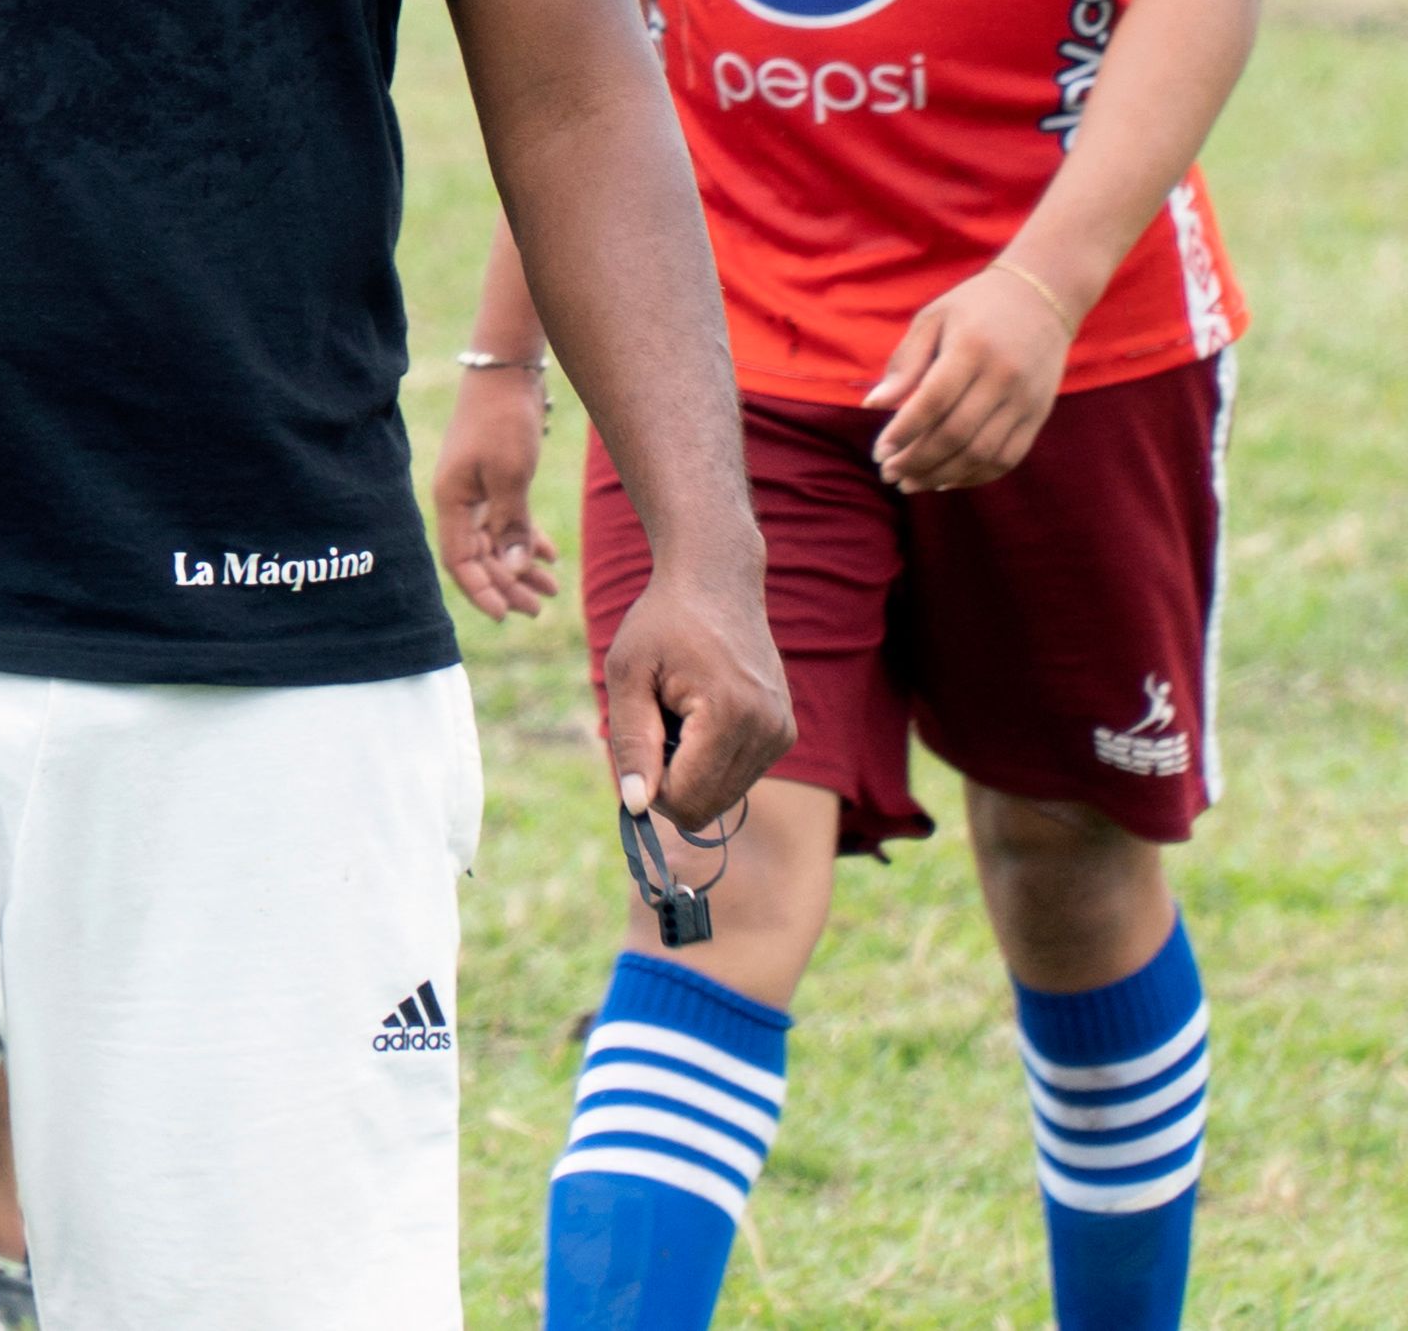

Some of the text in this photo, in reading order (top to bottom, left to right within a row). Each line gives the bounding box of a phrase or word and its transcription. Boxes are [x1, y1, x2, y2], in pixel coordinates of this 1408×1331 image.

[713, 51, 928, 125] pepsi
[173, 546, 375, 593] La Máquina
[372, 1025, 452, 1052] adidas
